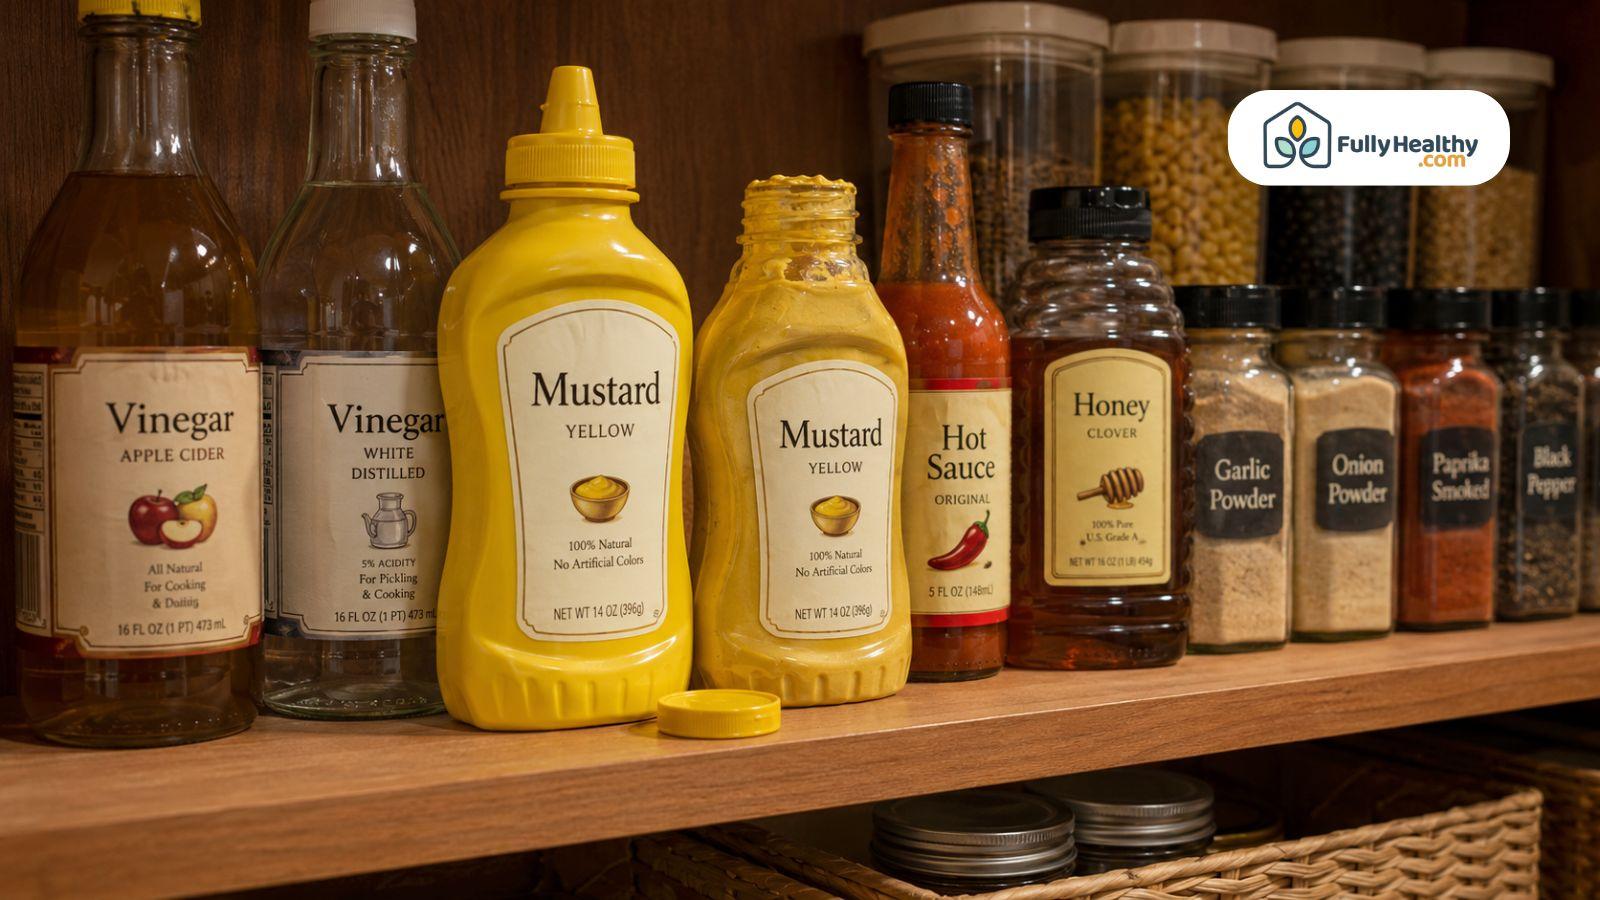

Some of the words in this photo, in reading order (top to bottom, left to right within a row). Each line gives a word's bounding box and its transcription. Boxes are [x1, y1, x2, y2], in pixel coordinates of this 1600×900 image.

[531, 370, 660, 407] Mustard
[1074, 392, 1150, 422] Honey
[106, 402, 234, 441] Vinegar
[326, 403, 444, 441] Vinegar
[566, 423, 635, 439] YELLOW
[780, 418, 882, 449] Mustard
[942, 424, 987, 451] Hot
[1087, 428, 1137, 439] CLOVER
[120, 450, 174, 463] APPLE
[179, 448, 225, 461] CIDER
[364, 447, 414, 460] WHITE
[1533, 444, 1572, 468] Black
[808, 461, 863, 474] YELLOW
[928, 453, 996, 480] Sauce
[1214, 457, 1271, 482] Garlic
[1332, 453, 1384, 476] Onion
[1432, 450, 1490, 479] Paprika
[352, 467, 425, 480] DISTILLED
[1328, 480, 1388, 505] Powder
[1431, 478, 1491, 502] Smoked
[1526, 473, 1577, 500] Pepper
[935, 494, 990, 505] ORIGINAL
[1210, 486, 1276, 511] Powder
[1092, 520, 1114, 529] 100%
[1116, 520, 1134, 528] Pure
[568, 540, 596, 551] 100%
[598, 537, 632, 550] Natural
[1105, 532, 1130, 542] Grade
[1132, 532, 1138, 541] A
[809, 550, 833, 561] 100%
[834, 548, 862, 560] Natural
[148, 564, 164, 575] All
[166, 561, 203, 574] Natural
[362, 560, 376, 568] 5%
[378, 558, 416, 568] ACIDITY
[553, 559, 570, 570] No
[572, 556, 614, 570] Artificial
[616, 554, 644, 567] Colors
[1069, 557, 1082, 567] NET
[1084, 557, 1095, 566] WT
[1106, 557, 1117, 566] OZ
[795, 567, 810, 578] No
[812, 565, 848, 577] Artificial
[850, 564, 873, 575] Colors
[144, 581, 162, 592] For
[164, 579, 206, 592] Cooking
[359, 574, 376, 584] For
[380, 573, 418, 585] Pickling
[362, 590, 371, 600] &
[374, 588, 416, 600] Cooking
[929, 586, 935, 597] 5
[938, 586, 948, 597] FL
[950, 586, 963, 597] OZ
[152, 598, 161, 608] &
[334, 612, 346, 622] 16
[348, 612, 360, 622] FL
[362, 612, 376, 622] OZ
[379, 611, 388, 623] (1
[391, 610, 406, 622] PT)
[408, 610, 424, 620] 473
[553, 607, 572, 620] NET
[575, 606, 591, 619] WT
[593, 606, 603, 618] 14
[606, 604, 618, 617] OZ
[620, 602, 644, 618] (396g)
[795, 608, 812, 620] NET
[814, 608, 828, 619] WT
[829, 607, 838, 618] 14
[840, 606, 850, 618] OZ
[118, 624, 130, 636] 16
[133, 624, 145, 636] FL
[148, 623, 164, 635] OZ
[166, 622, 175, 636] (1
[178, 620, 194, 634] PT)
[196, 619, 212, 631] 473
[214, 618, 226, 630] mL
